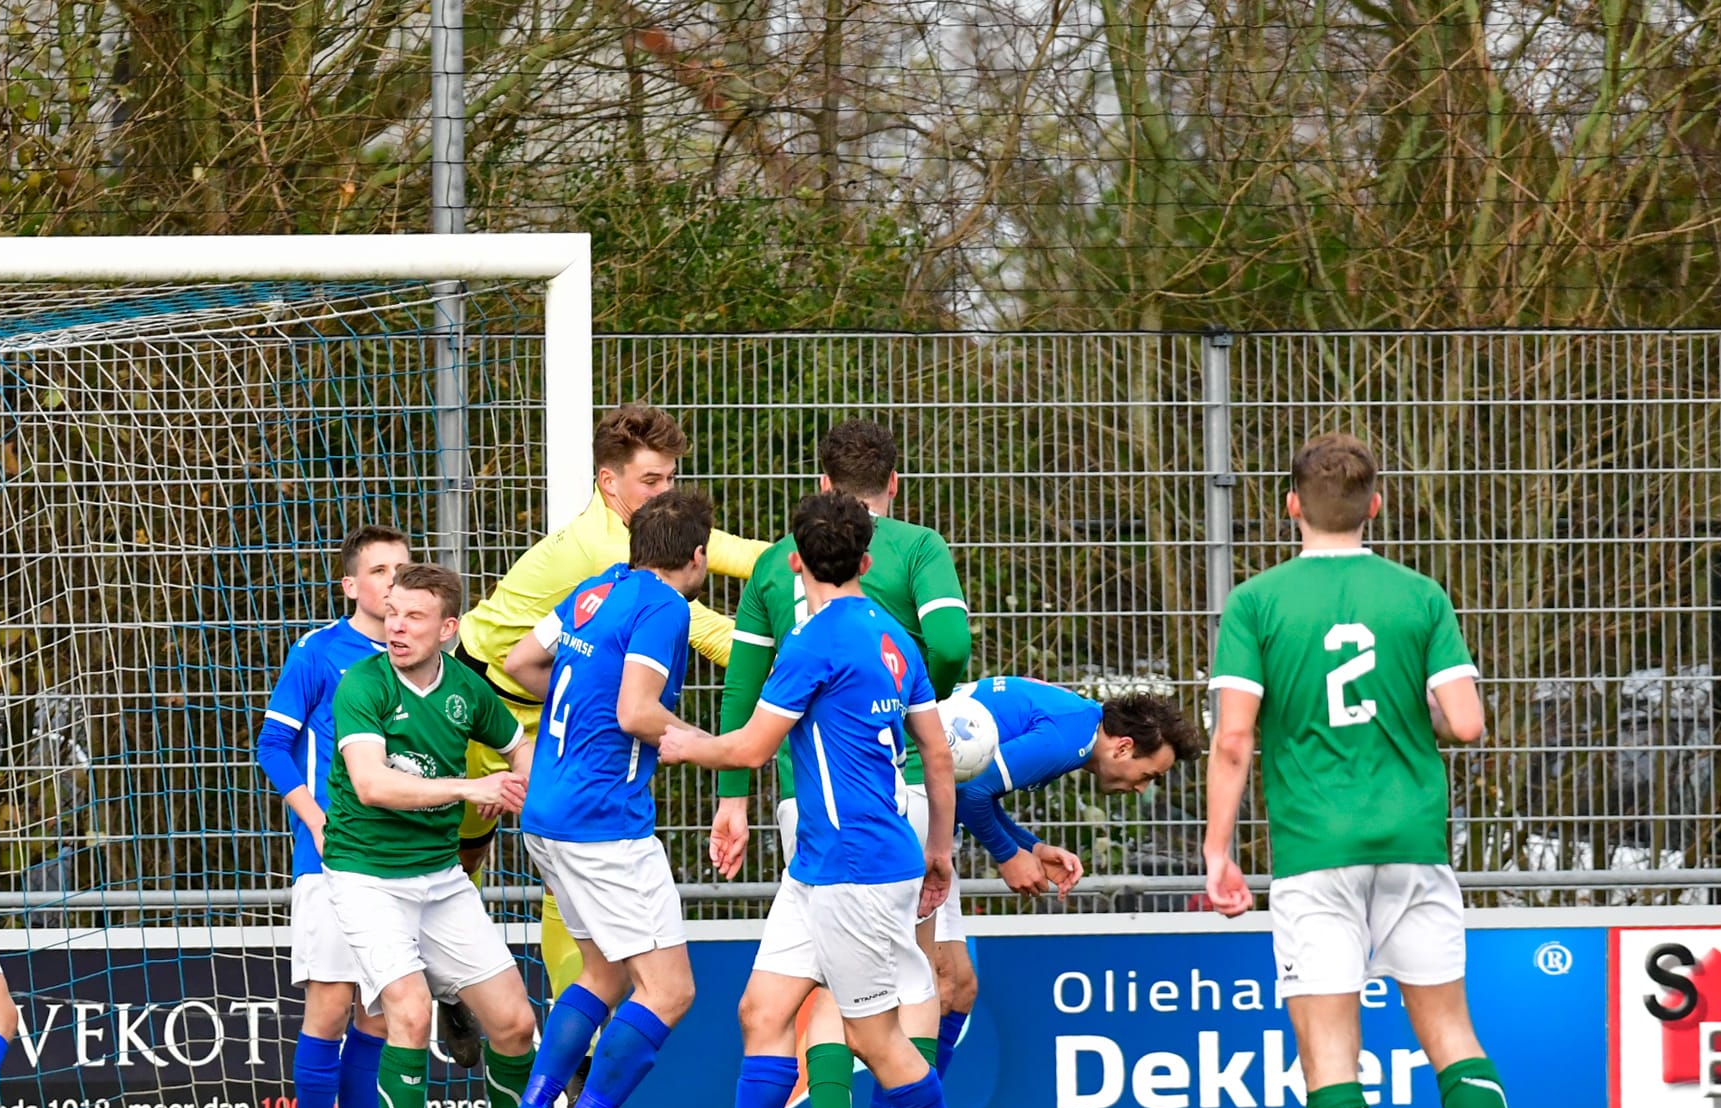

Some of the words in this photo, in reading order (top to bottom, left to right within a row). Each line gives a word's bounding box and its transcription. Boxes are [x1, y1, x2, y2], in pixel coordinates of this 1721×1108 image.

[549, 665, 572, 757] 4
[1324, 623, 1376, 727] 2
[1053, 968, 1405, 1013] Oliehae
[1643, 943, 1698, 1021] S
